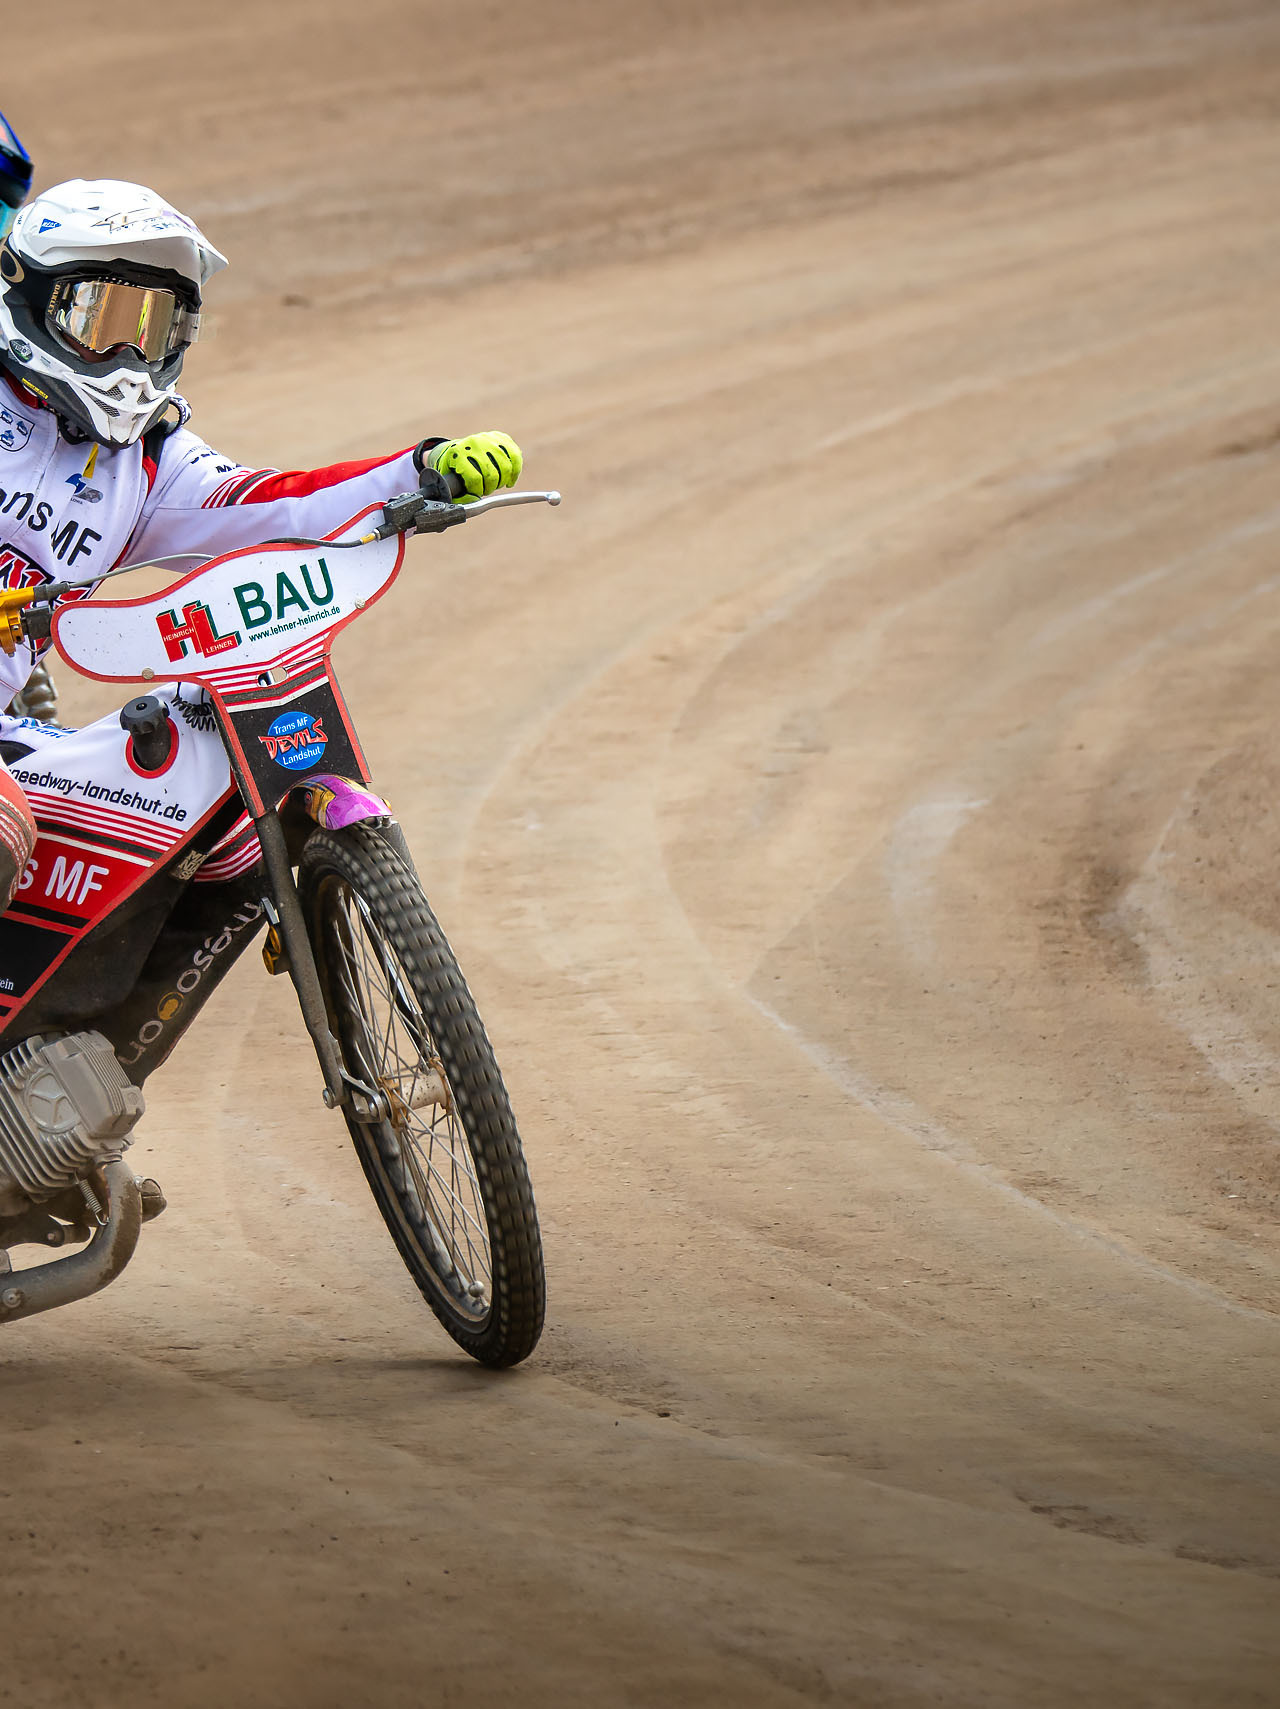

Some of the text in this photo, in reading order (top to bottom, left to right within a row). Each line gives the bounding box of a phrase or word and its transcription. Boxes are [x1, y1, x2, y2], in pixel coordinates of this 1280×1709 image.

[51, 520, 103, 567] MF
[233, 558, 335, 631] BAU
[163, 627, 195, 642] HEINRICH
[248, 605, 341, 643] www.lehner-heinrich.de
[205, 639, 233, 654] LEHNER
[258, 717, 329, 760] DEVILS
[274, 716, 308, 734] Trans MF
[282, 745, 322, 765] Landshut
[9, 768, 187, 823] peedway-landshut.de
[45, 856, 109, 905] MF
